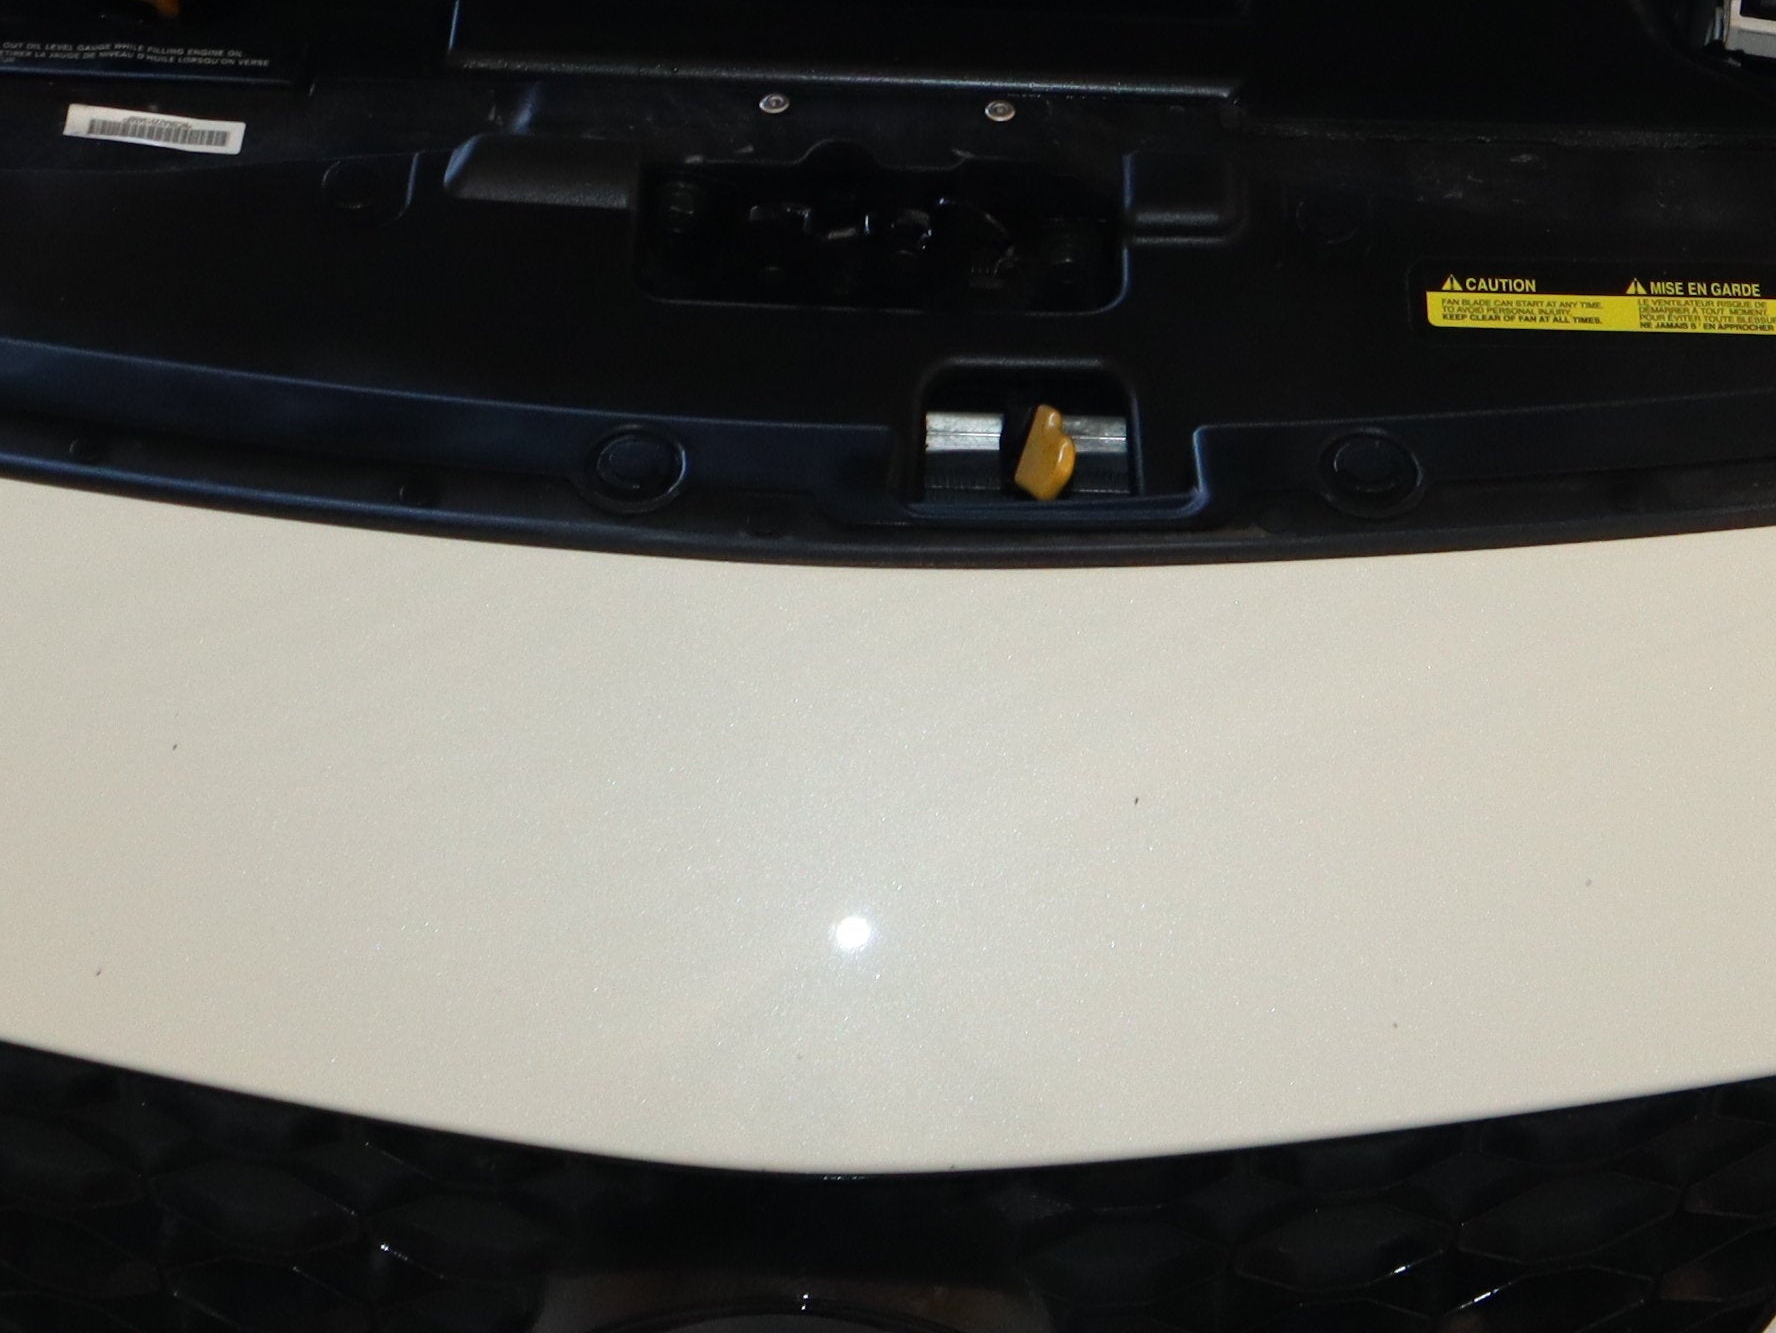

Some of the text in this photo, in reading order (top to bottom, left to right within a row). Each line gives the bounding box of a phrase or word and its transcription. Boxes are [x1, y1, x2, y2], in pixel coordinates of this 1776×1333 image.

[1466, 277, 1536, 292] CAUTION
[1650, 281, 1761, 297] MISE EN GARDE
[1441, 298, 1459, 306] FAN
[1462, 299, 1492, 307] BLADE
[1516, 300, 1544, 308] START
[1651, 299, 1714, 307] VENTILATEUR
[1456, 306, 1484, 314] AVOID
[1486, 307, 1535, 315] PERSONAL
[1519, 315, 1536, 323] FAN
[1640, 314, 1666, 322] POUR
[1704, 315, 1735, 323] TOUTE
[1655, 322, 1688, 330] JAMAIS
[1717, 324, 1774, 332] APPROCHER
